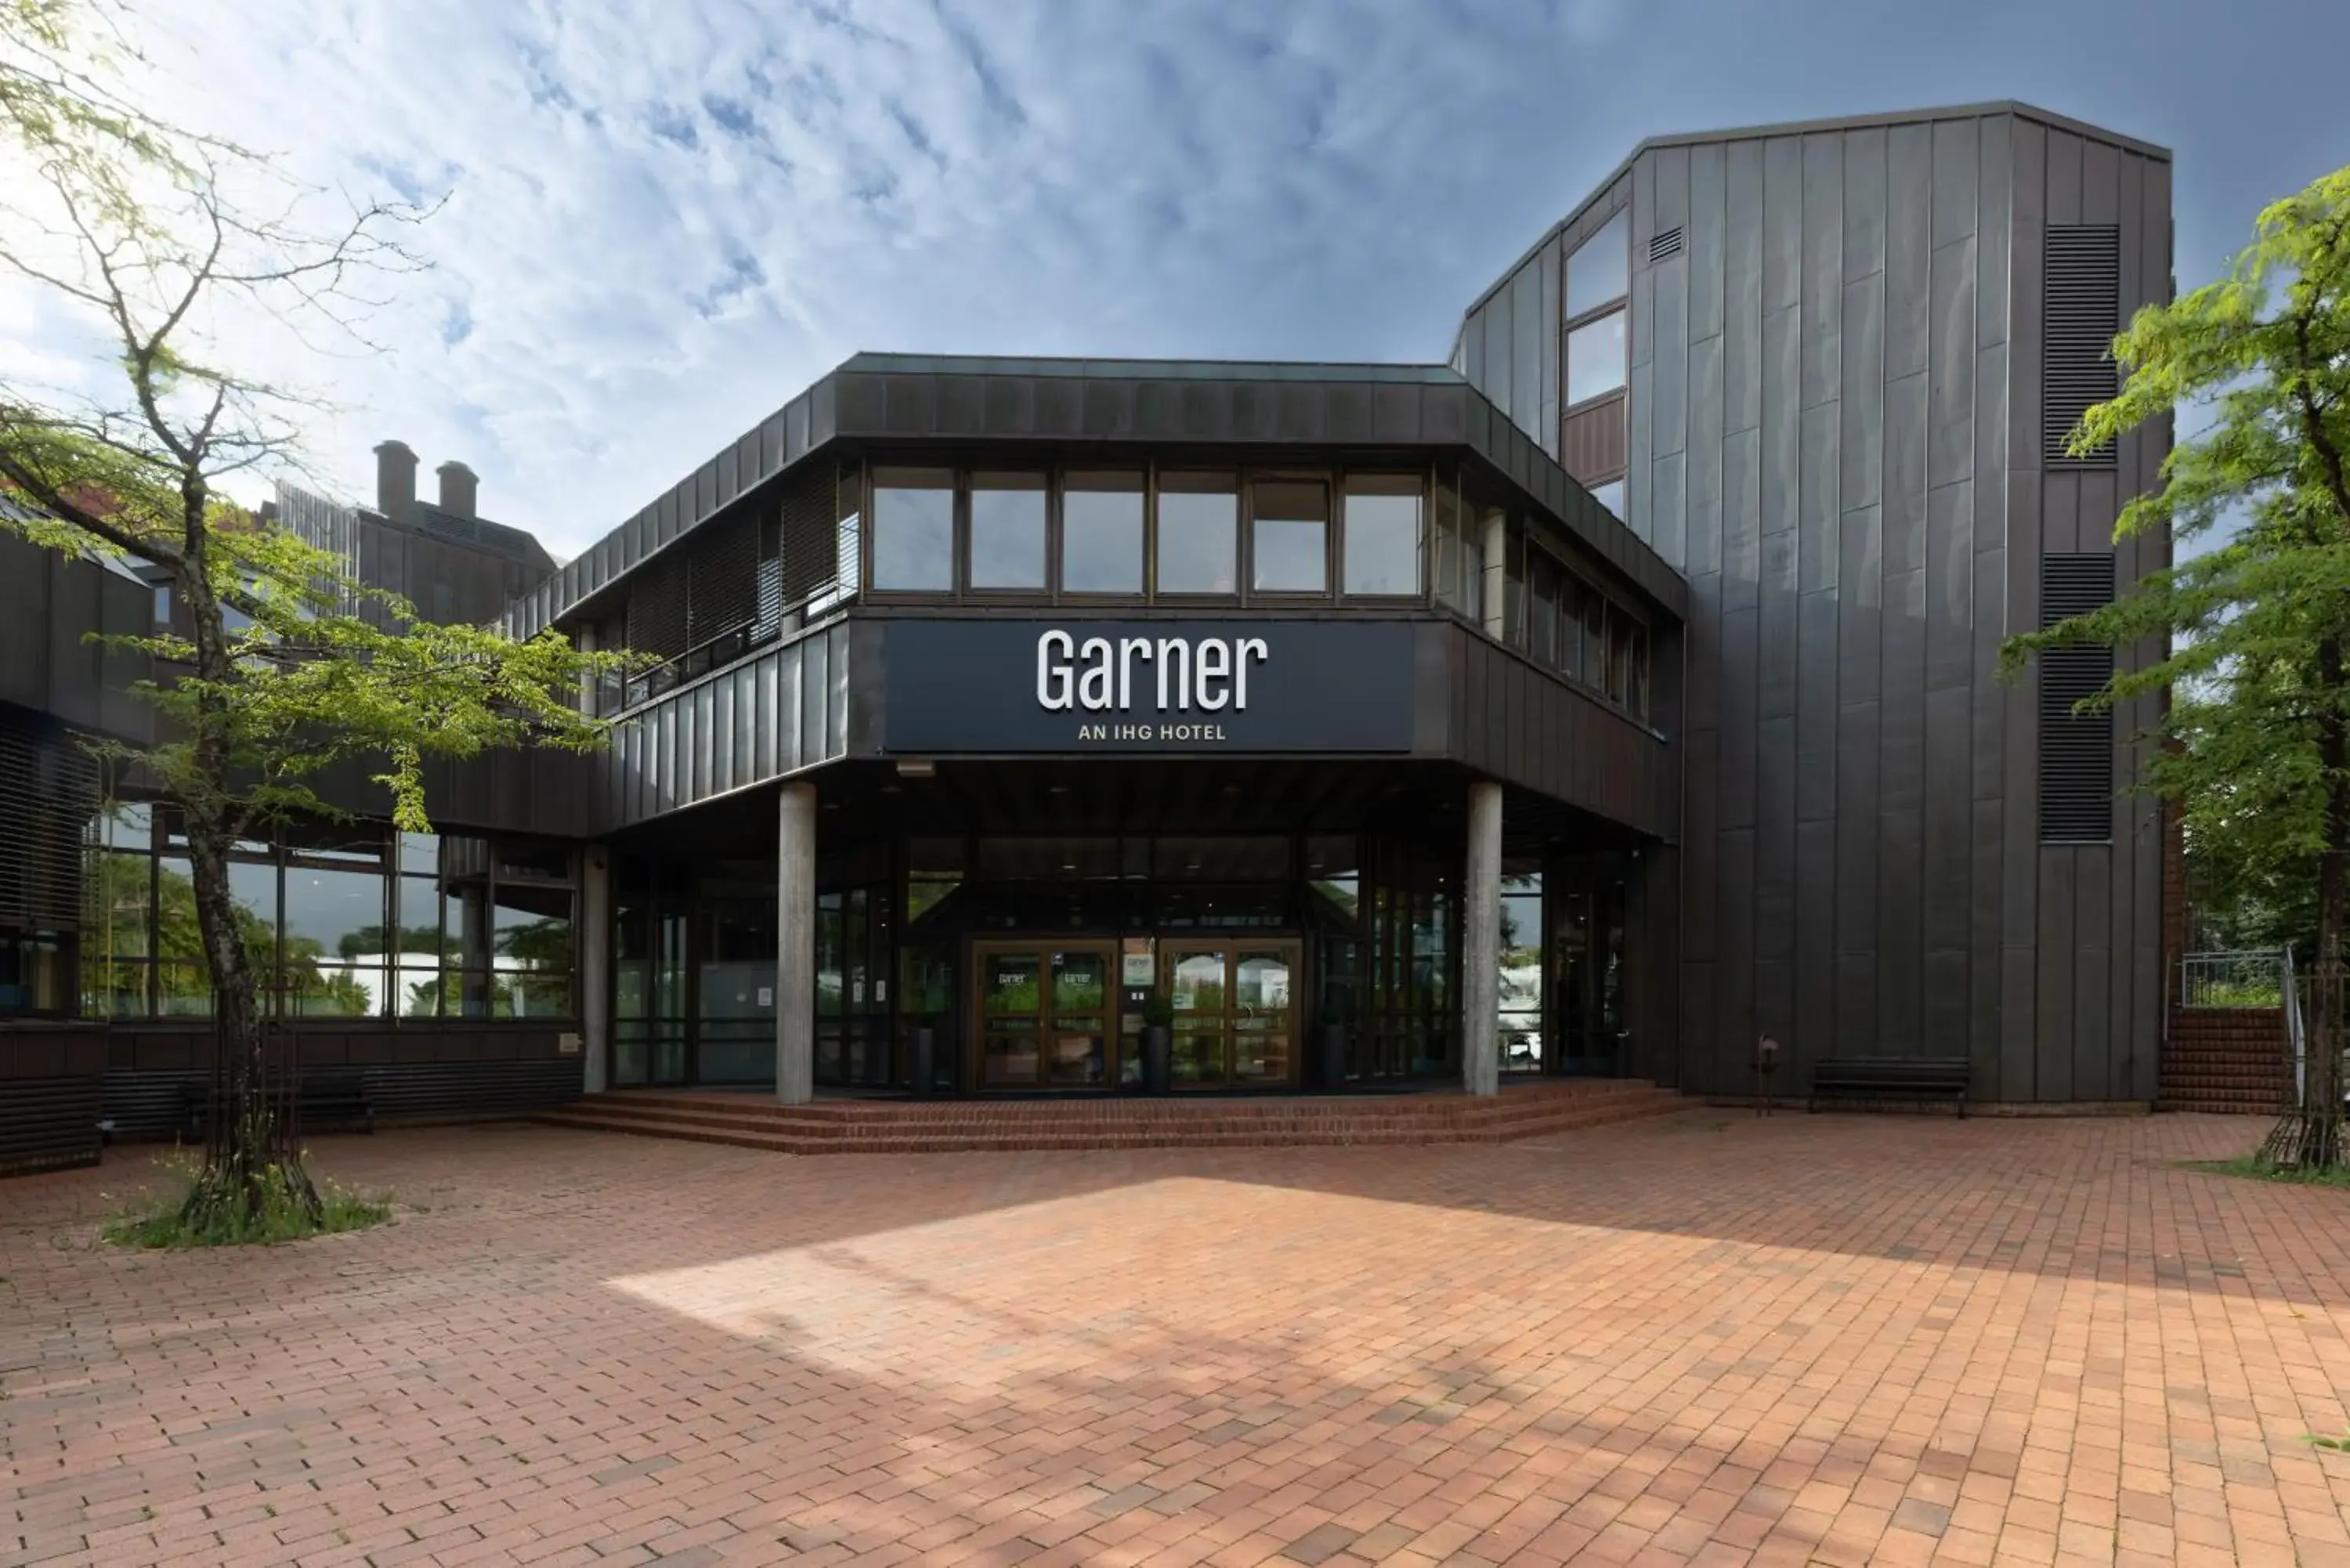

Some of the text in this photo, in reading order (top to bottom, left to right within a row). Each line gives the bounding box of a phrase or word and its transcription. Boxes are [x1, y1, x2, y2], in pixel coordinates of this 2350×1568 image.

[1037, 629, 1268, 710] Garner
[1079, 724, 1226, 739] AN IHG HOTEL
